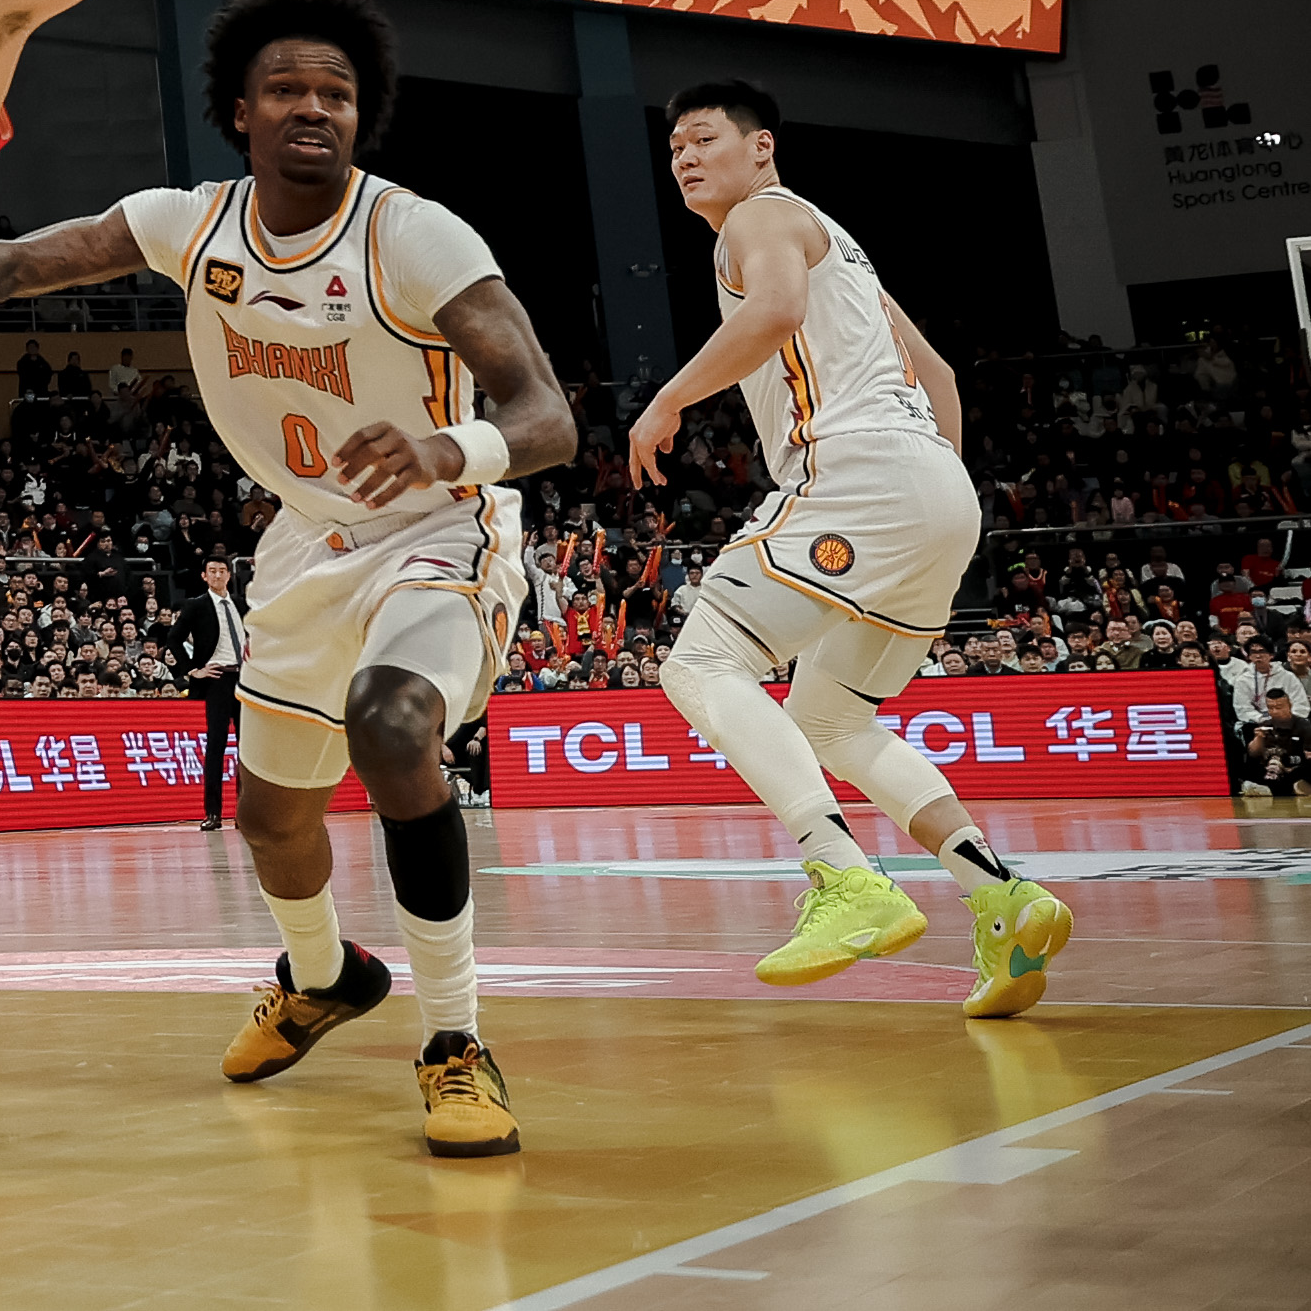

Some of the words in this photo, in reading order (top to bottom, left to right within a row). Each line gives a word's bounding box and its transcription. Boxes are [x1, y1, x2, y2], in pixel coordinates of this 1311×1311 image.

[1165, 134, 1303, 165] 黄龙体育心
[1168, 161, 1283, 184] Huanglong
[1173, 190, 1235, 209] Sports
[1242, 182, 1310, 200] Centre
[216, 311, 355, 406] SHANXI
[281, 412, 328, 478] 0
[509, 722, 670, 774] TCL
[1045, 704, 1198, 763] 华星
[34, 734, 111, 791] 华星
